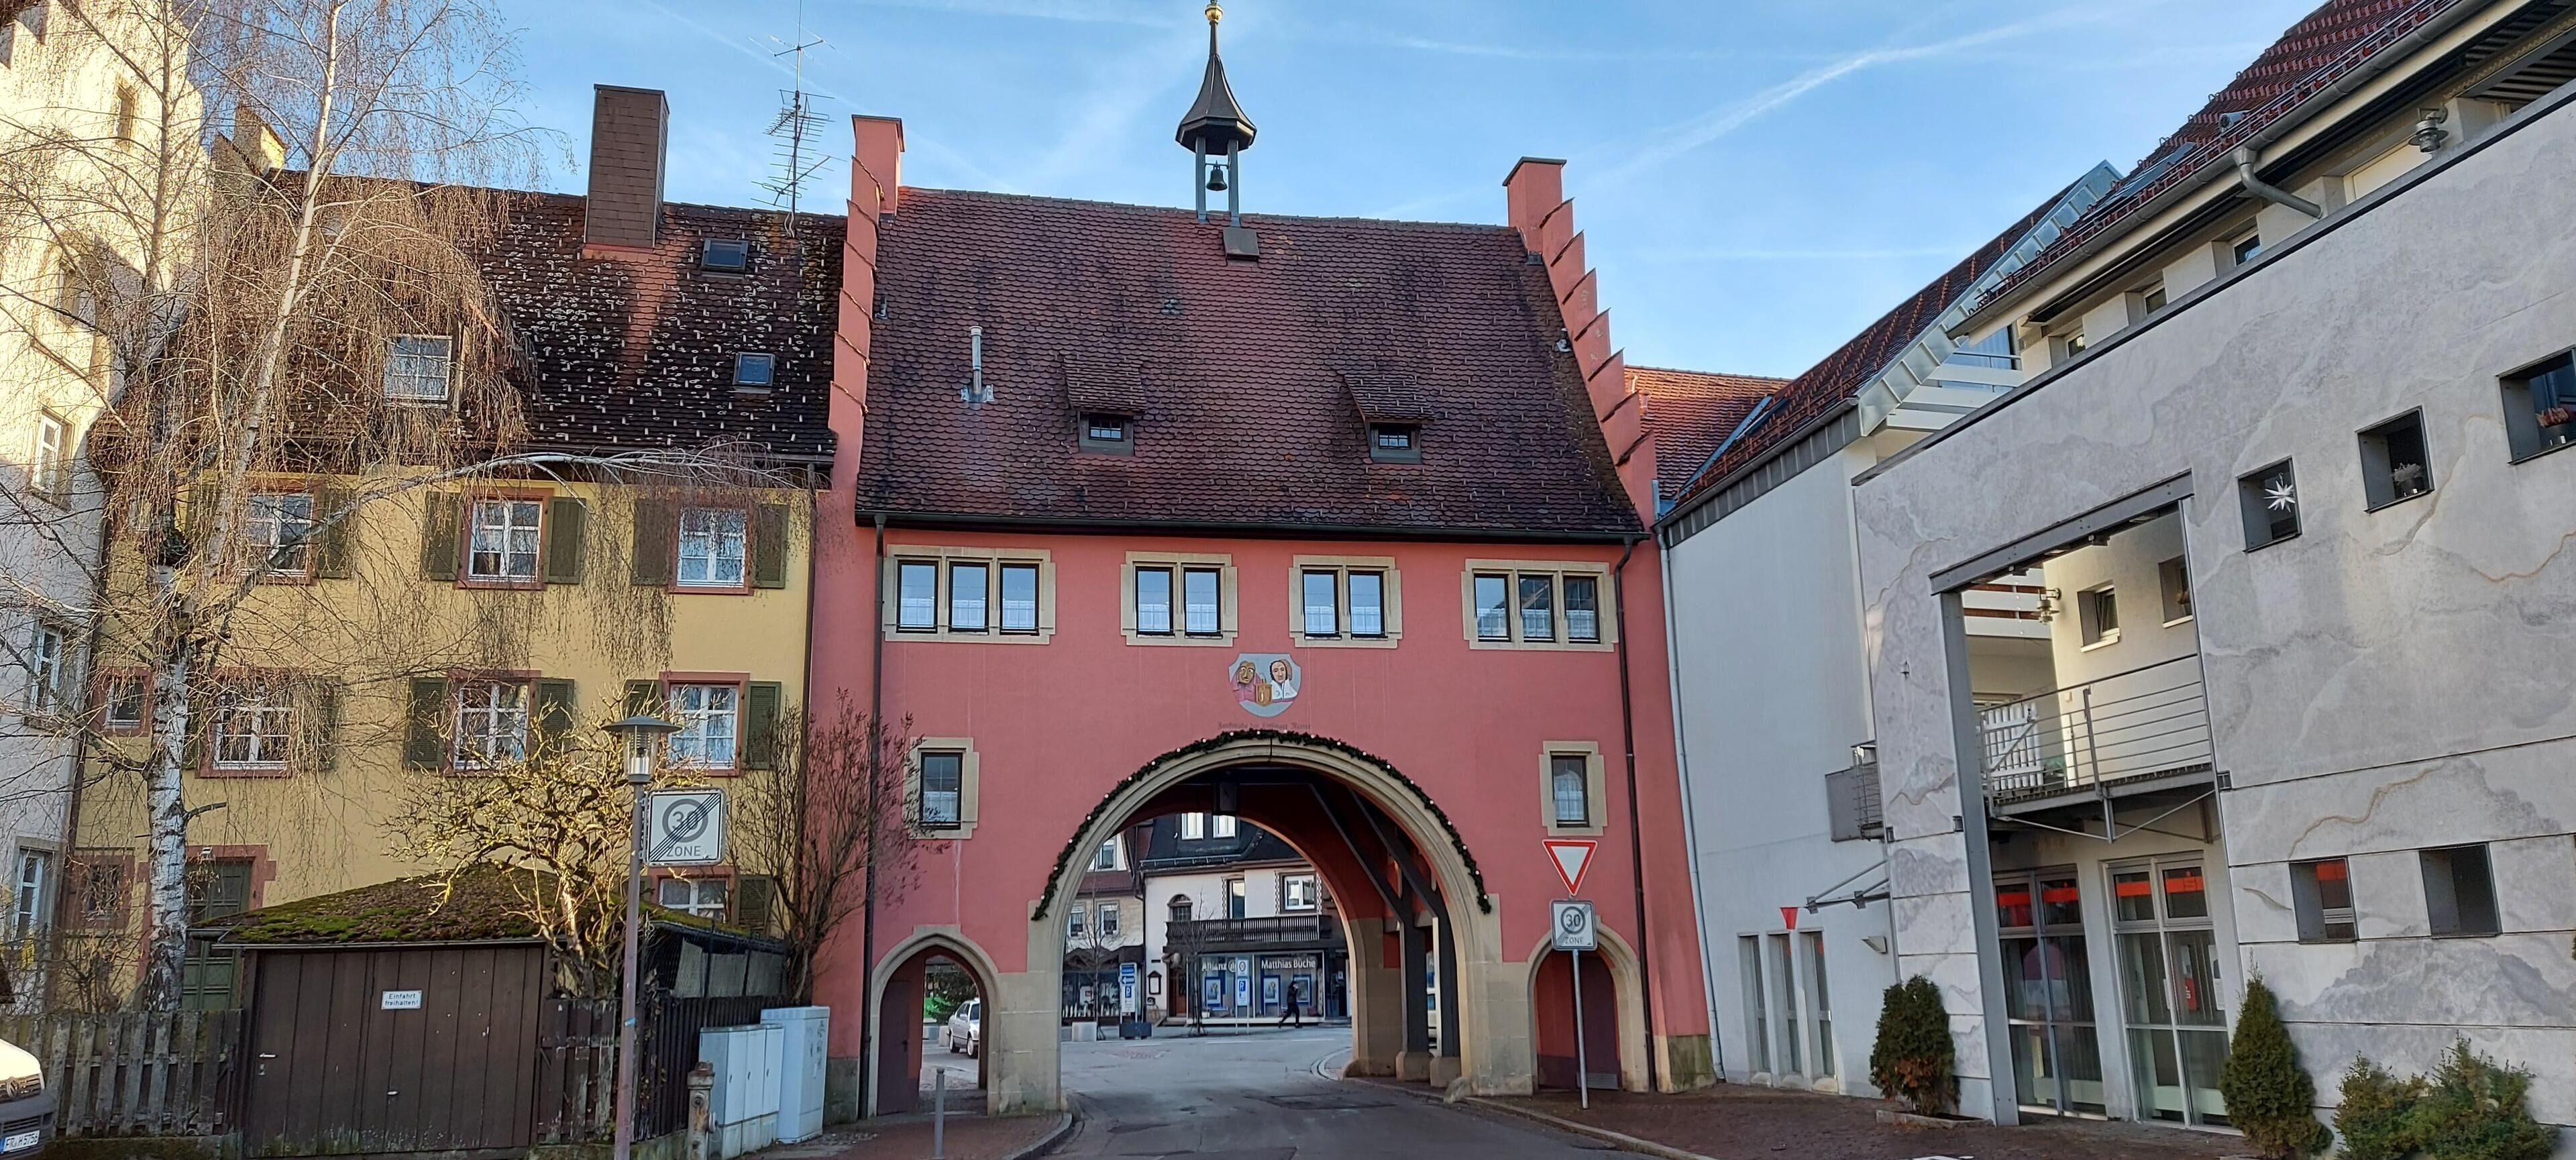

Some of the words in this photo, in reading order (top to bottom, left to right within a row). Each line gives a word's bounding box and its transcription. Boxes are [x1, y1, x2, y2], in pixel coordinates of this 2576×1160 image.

[666, 846, 702, 857] ZONE
[1566, 914, 1580, 927] 30
[1565, 937, 1584, 945] ZONE
[1261, 958, 1292, 969] Matthias
